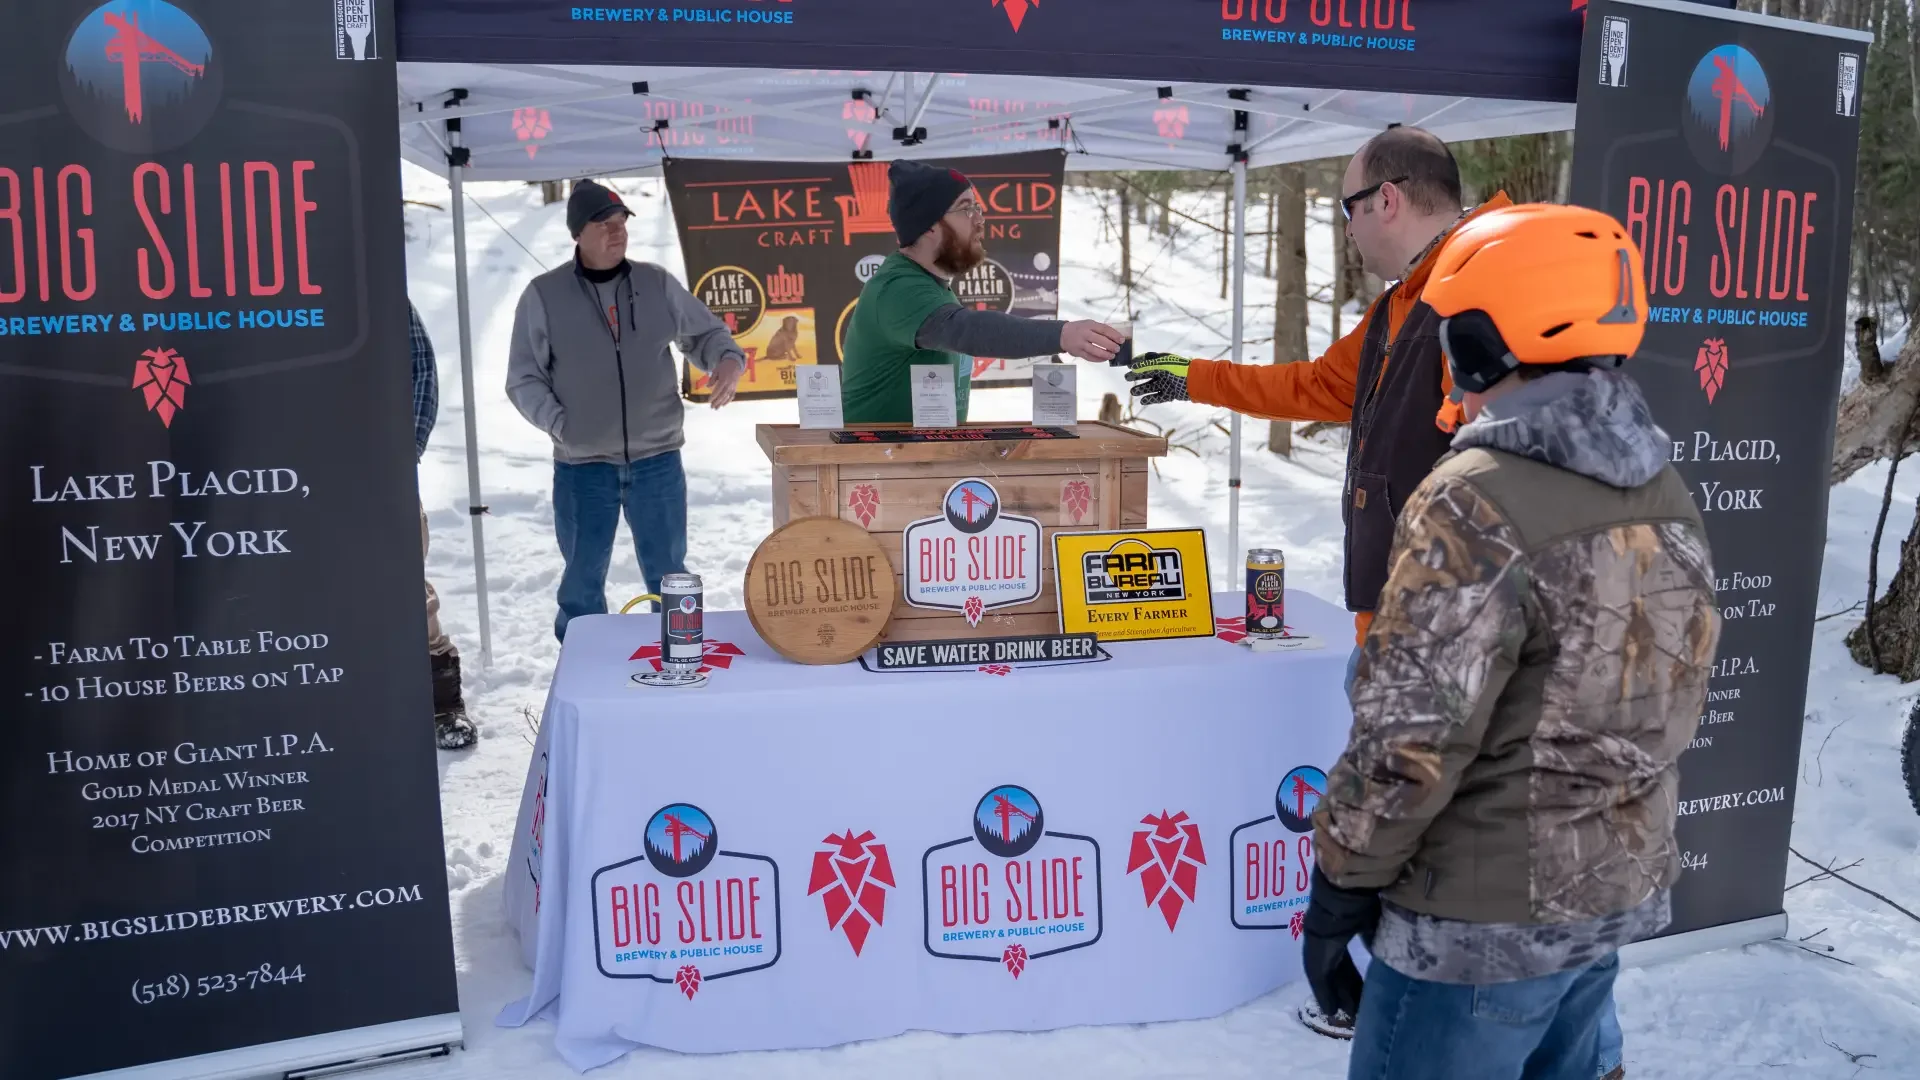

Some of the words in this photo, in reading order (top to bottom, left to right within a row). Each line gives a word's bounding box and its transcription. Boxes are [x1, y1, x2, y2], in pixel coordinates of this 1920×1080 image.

[346, 6, 364, 14] PEN
[346, 14, 369, 22] DENT
[571, 8, 654, 22] BREWERY
[657, 8, 670, 22] &
[673, 9, 732, 23] PUBLIC
[736, 10, 794, 24] HOUSE
[1222, 28, 1297, 45] BREWERY
[1298, 32, 1308, 45] &
[1312, 34, 1363, 49] PUBLIC
[1366, 37, 1416, 52] HOUSE
[712, 187, 822, 222] LAKE
[971, 182, 1056, 213] ACID
[0, 164, 96, 302] BIG
[133, 160, 322, 300] SLIDE
[758, 229, 834, 248] CRAFT
[1626, 176, 1692, 296] BIG
[1710, 184, 1818, 302] SLIDE
[712, 274, 744, 290] LAKE
[964, 264, 996, 280] LAKE
[705, 288, 753, 306] PLACID
[958, 280, 1004, 296] PLACID
[119, 314, 136, 332] &
[143, 310, 232, 332] PUBLIC
[239, 308, 324, 328] HOUSE
[1648, 306, 1690, 324] WERY
[1692, 308, 1703, 324] &
[1707, 308, 1756, 326] PUBLIC
[1759, 311, 1808, 327] HOUSE
[1691, 430, 1781, 464] PLACID,
[30, 465, 136, 502] LAKE
[147, 460, 310, 498] PLACID,
[1700, 482, 1764, 512] YORK
[60, 525, 162, 564] NEW
[170, 521, 292, 558] YORK
[920, 536, 956, 583] BIG
[968, 534, 1026, 581] SLIDE
[1086, 552, 1179, 574] FARM
[764, 560, 804, 606] BIG
[814, 556, 878, 604] SLIDE
[920, 584, 960, 594] BREWERY
[968, 584, 998, 592] PUBLIC
[999, 582, 1026, 590] HOUSE
[1088, 572, 1181, 589] BUREAU
[1732, 572, 1772, 590] FOOD
[768, 608, 810, 618] BREWERY
[818, 604, 848, 614] PUBLIC
[850, 603, 880, 611] HOUSE
[1086, 609, 1129, 624] EVERY
[1133, 607, 1188, 620] FARMER
[1724, 606, 1745, 620] ON
[1748, 600, 1776, 618] TAP
[1160, 624, 1196, 635] Agriculture
[50, 642, 126, 665] FARM
[130, 636, 168, 660] TO
[173, 634, 252, 658] TABLE
[258, 630, 329, 653] FOOD
[883, 645, 927, 666] SAVE
[932, 642, 990, 664] WATER
[994, 639, 1047, 660] DRINK
[1051, 636, 1093, 658] BEER
[1720, 656, 1760, 676] I.P.A.
[40, 684, 70, 702] 10
[76, 676, 168, 699] HOUSE
[174, 672, 246, 694] BEERS
[252, 670, 289, 690] ON
[294, 663, 344, 686] TAP
[1708, 710, 1735, 724] BEER
[48, 750, 132, 774] HOME
[137, 750, 168, 767] OF
[174, 742, 258, 764] GIANT
[263, 732, 334, 757] I.P.A.
[81, 782, 142, 801] GOLD
[148, 778, 221, 797] MEDAL
[223, 770, 310, 790] WINNER
[92, 814, 140, 830] 2017
[145, 805, 182, 825] NY
[186, 803, 252, 822] CRAFT
[256, 797, 306, 814] BEER
[131, 828, 272, 854] COMPETITION
[1246, 840, 1286, 900] BIG
[941, 862, 990, 928] BIG
[1005, 856, 1084, 922] SLIDE
[611, 883, 661, 948] BIG
[676, 877, 762, 944] SLIDE
[1246, 900, 1288, 914] BREWERY
[1288, 898, 1294, 908] &
[1296, 896, 1311, 906] PUB
[942, 930, 996, 942] BREWERY
[998, 929, 1005, 938] &
[1008, 926, 1046, 937] PUBLIC
[1048, 922, 1085, 934] HOUSE
[616, 950, 668, 962] BREWERY
[670, 950, 677, 959] &
[680, 947, 720, 958] PUBLIC
[724, 944, 764, 955] HOUSE
[131, 973, 190, 1004] (518)
[197, 962, 306, 996] 523-7844
